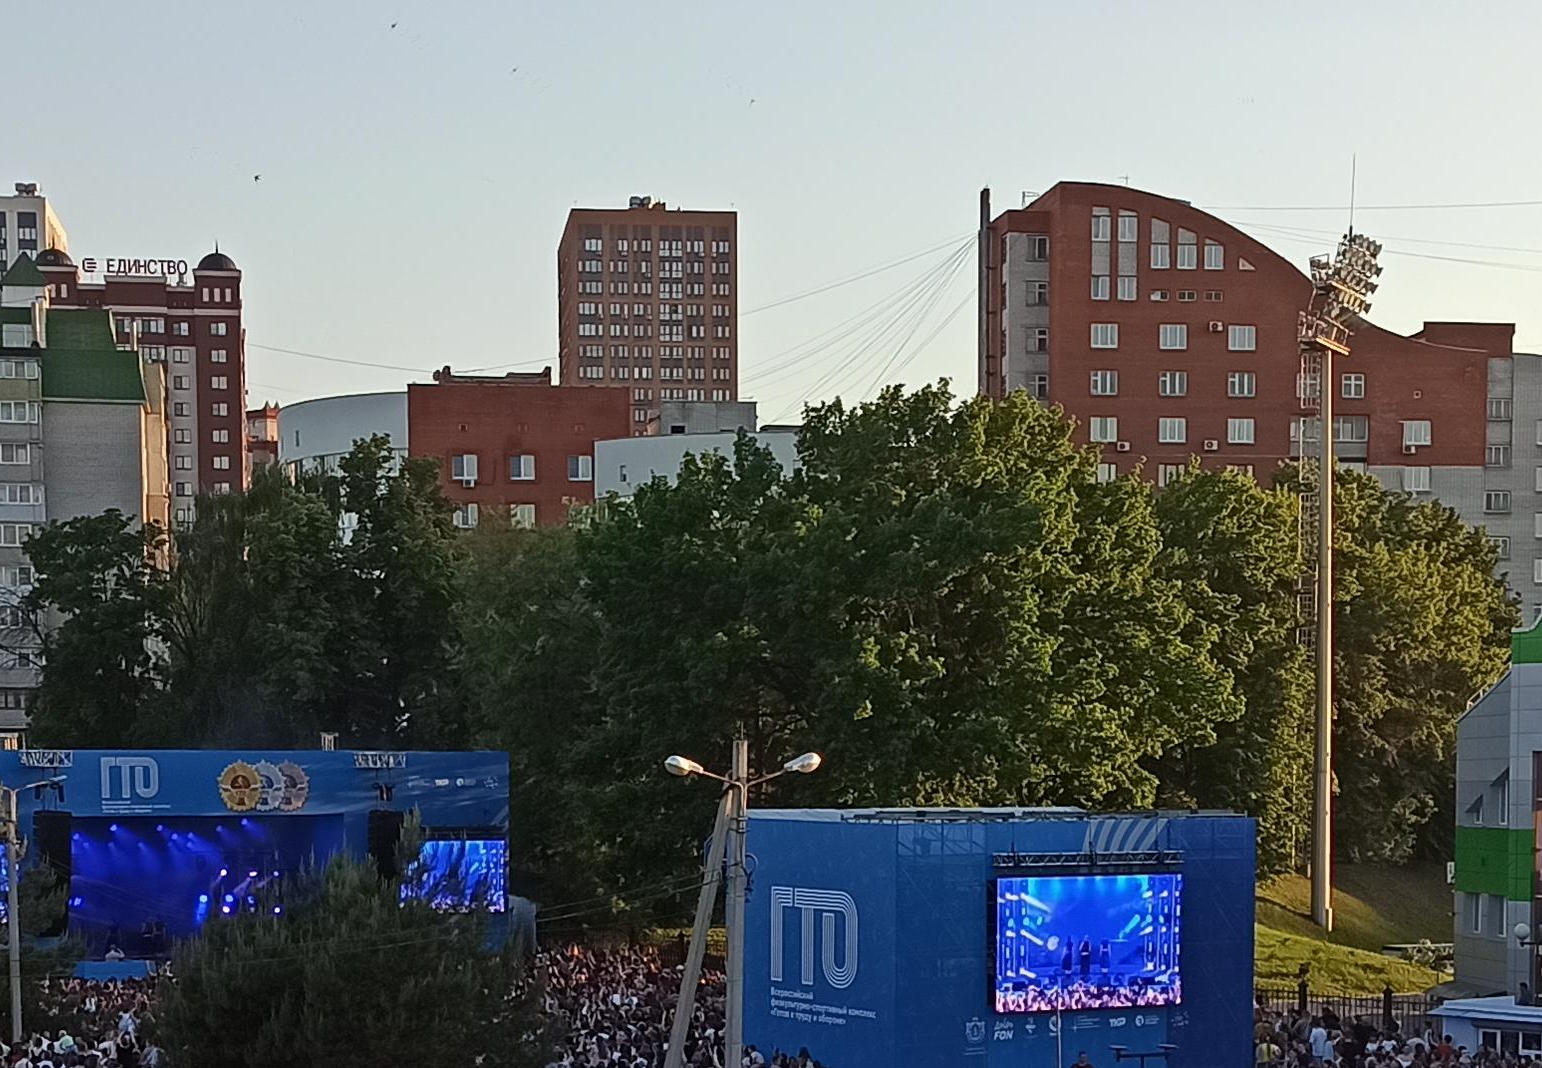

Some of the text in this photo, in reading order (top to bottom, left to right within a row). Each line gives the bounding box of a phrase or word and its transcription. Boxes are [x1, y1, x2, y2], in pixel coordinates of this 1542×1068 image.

[106, 258, 188, 276] ЕДИНСТВО
[100, 756, 159, 799] ГТО
[770, 886, 859, 989] ГТО
[993, 1029, 1014, 1041] FON
